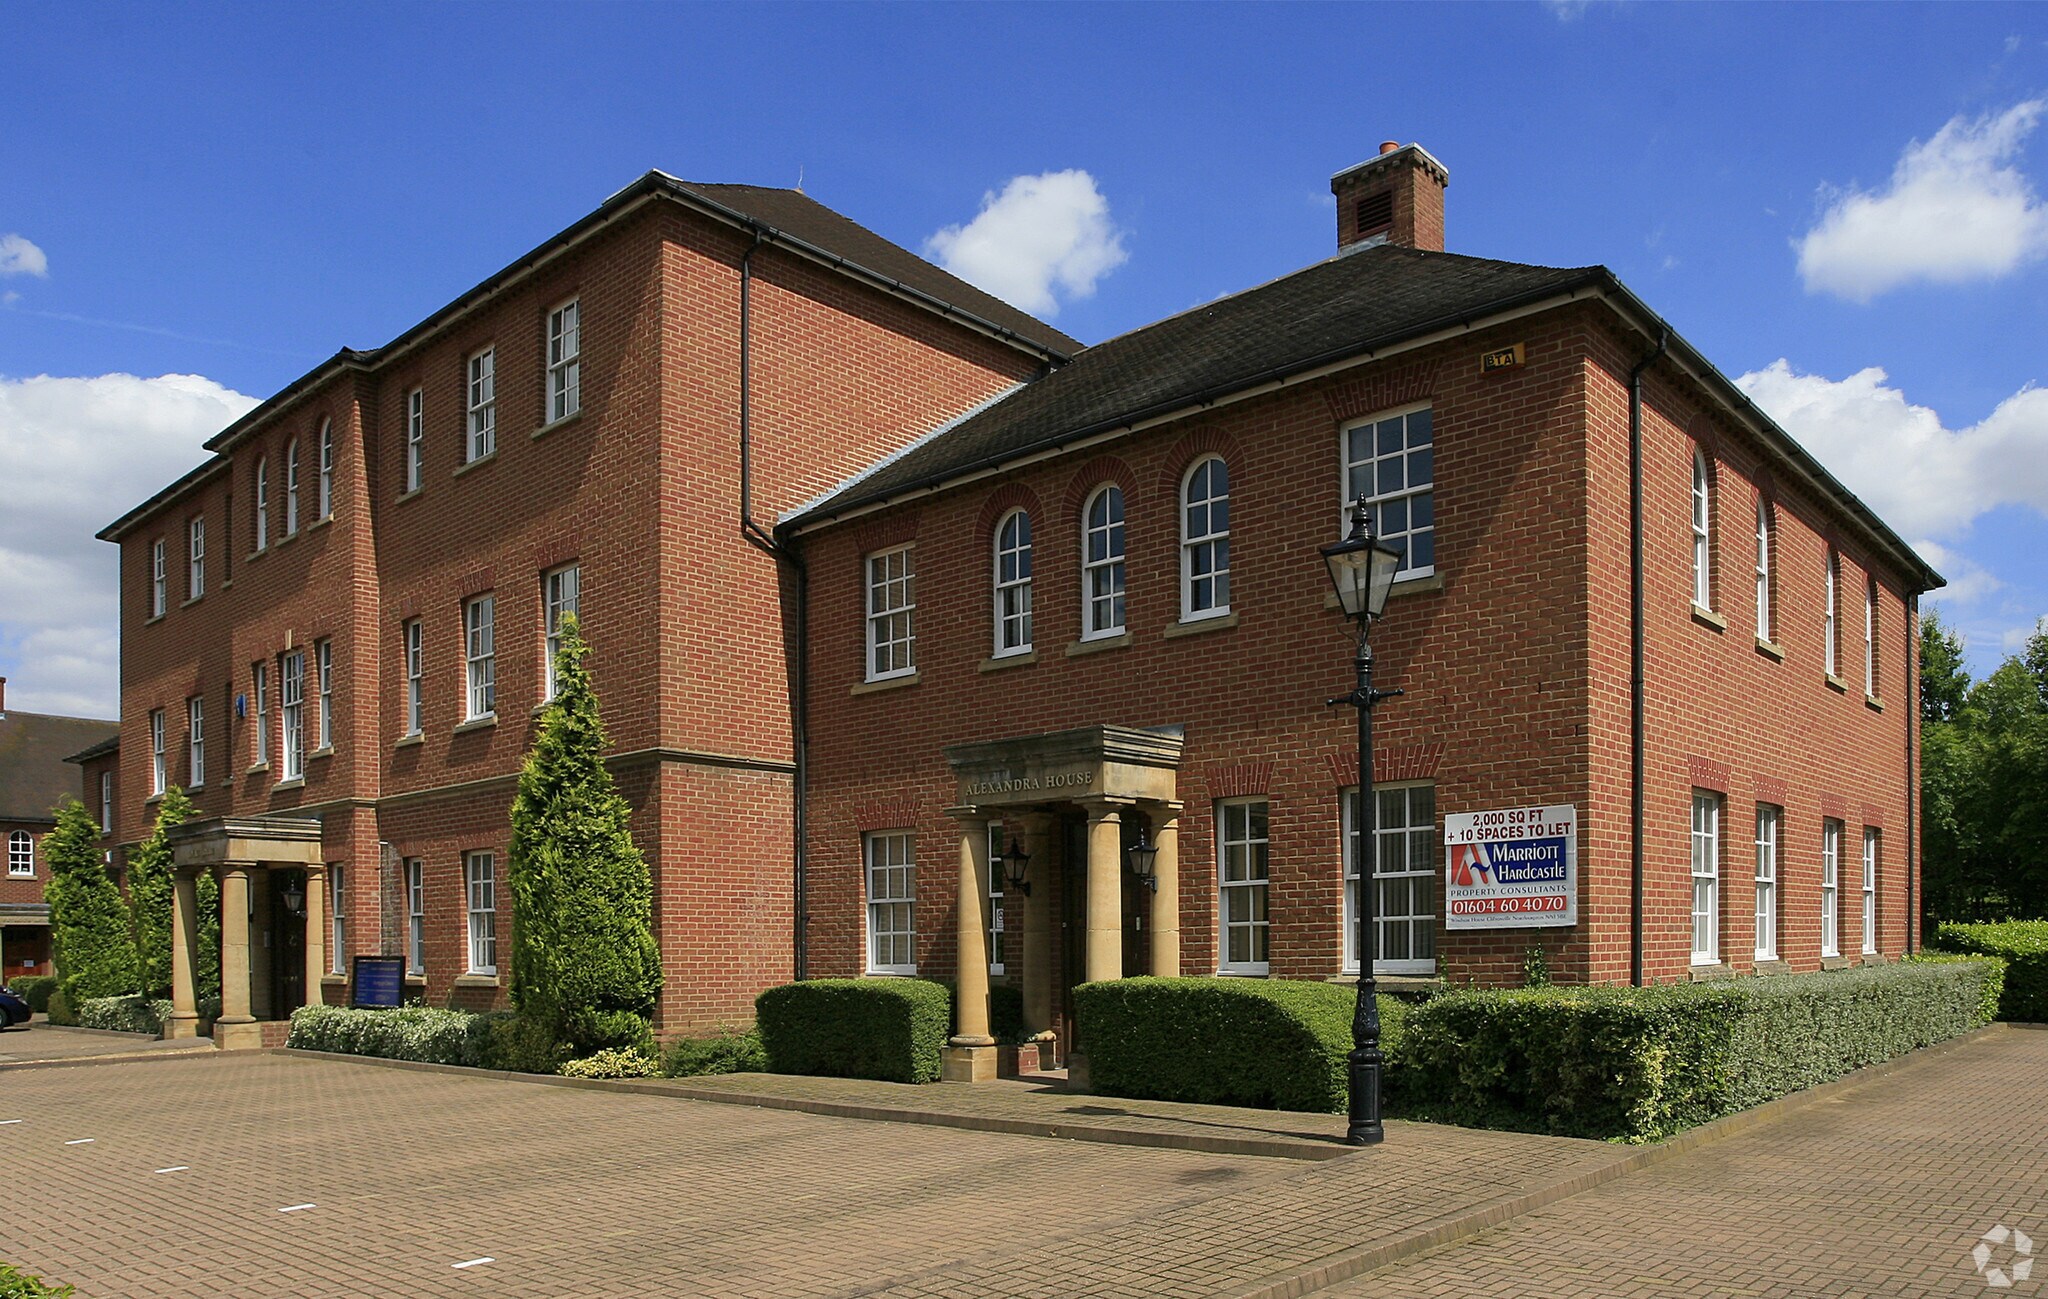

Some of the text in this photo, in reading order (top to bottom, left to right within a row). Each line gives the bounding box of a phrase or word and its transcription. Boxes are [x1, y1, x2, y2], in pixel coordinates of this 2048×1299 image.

[1487, 354, 1512, 366] BTA
[965, 771, 1092, 796] ALEXANDRA HOUSE
[1473, 809, 1544, 828] 2,000 SQ FT
[1460, 829, 1473, 841] 10
[1477, 825, 1524, 840] SPACES
[1527, 824, 1544, 837] TO
[1548, 822, 1571, 836] LET
[1450, 885, 1567, 897] PROPERTY CONSULTANTS
[1454, 896, 1564, 914] 01604 60 40 70
